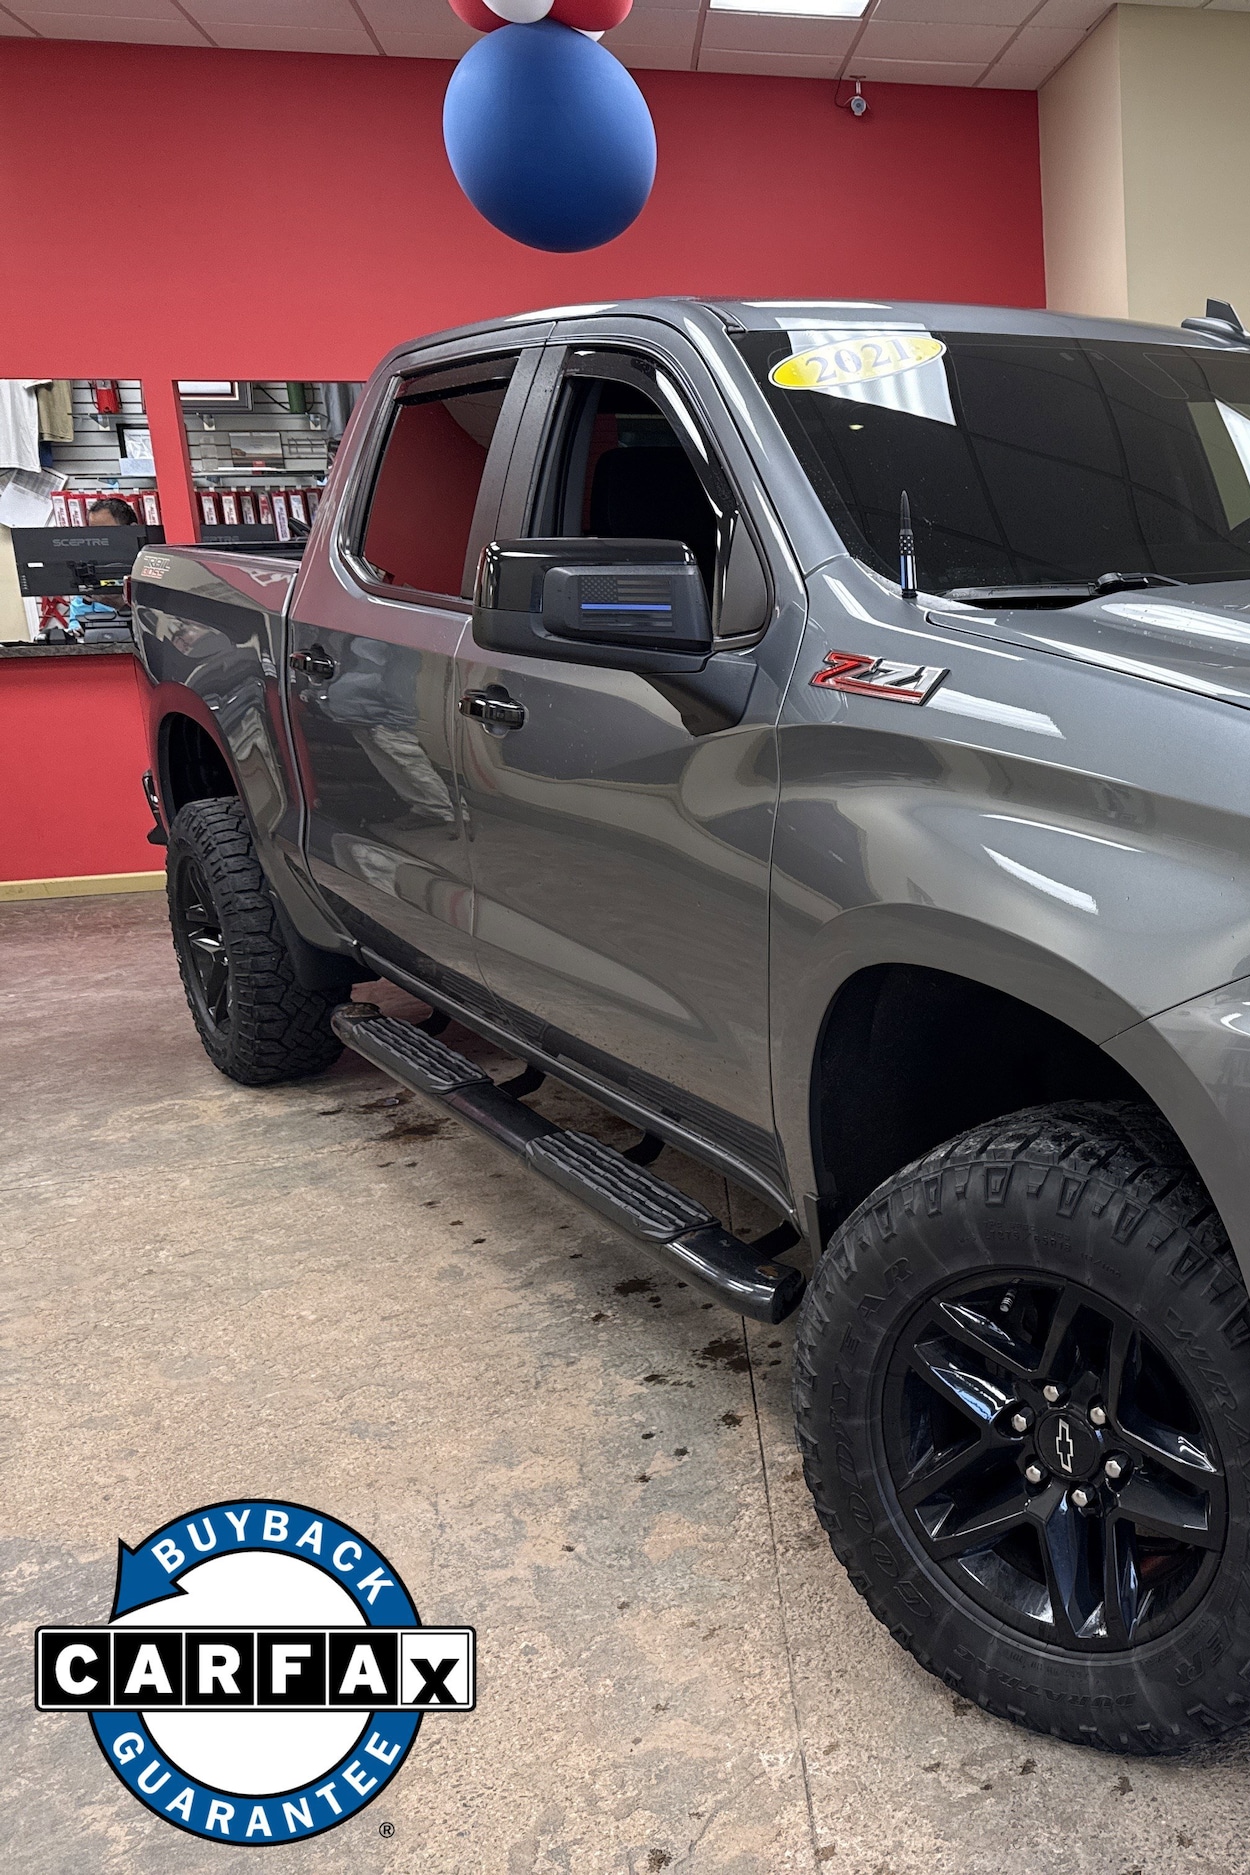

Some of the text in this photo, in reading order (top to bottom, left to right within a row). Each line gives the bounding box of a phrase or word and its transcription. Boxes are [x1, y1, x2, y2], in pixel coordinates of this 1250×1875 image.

[803, 337, 912, 385] 2021
[52, 538, 110, 547] SCEPTRE
[144, 555, 171, 571] TRAIL
[141, 568, 165, 580] BOSS
[808, 649, 951, 706] Z71
[830, 1257, 932, 1618] GOODYEAR
[954, 1643, 1137, 1710] DURATRAC
